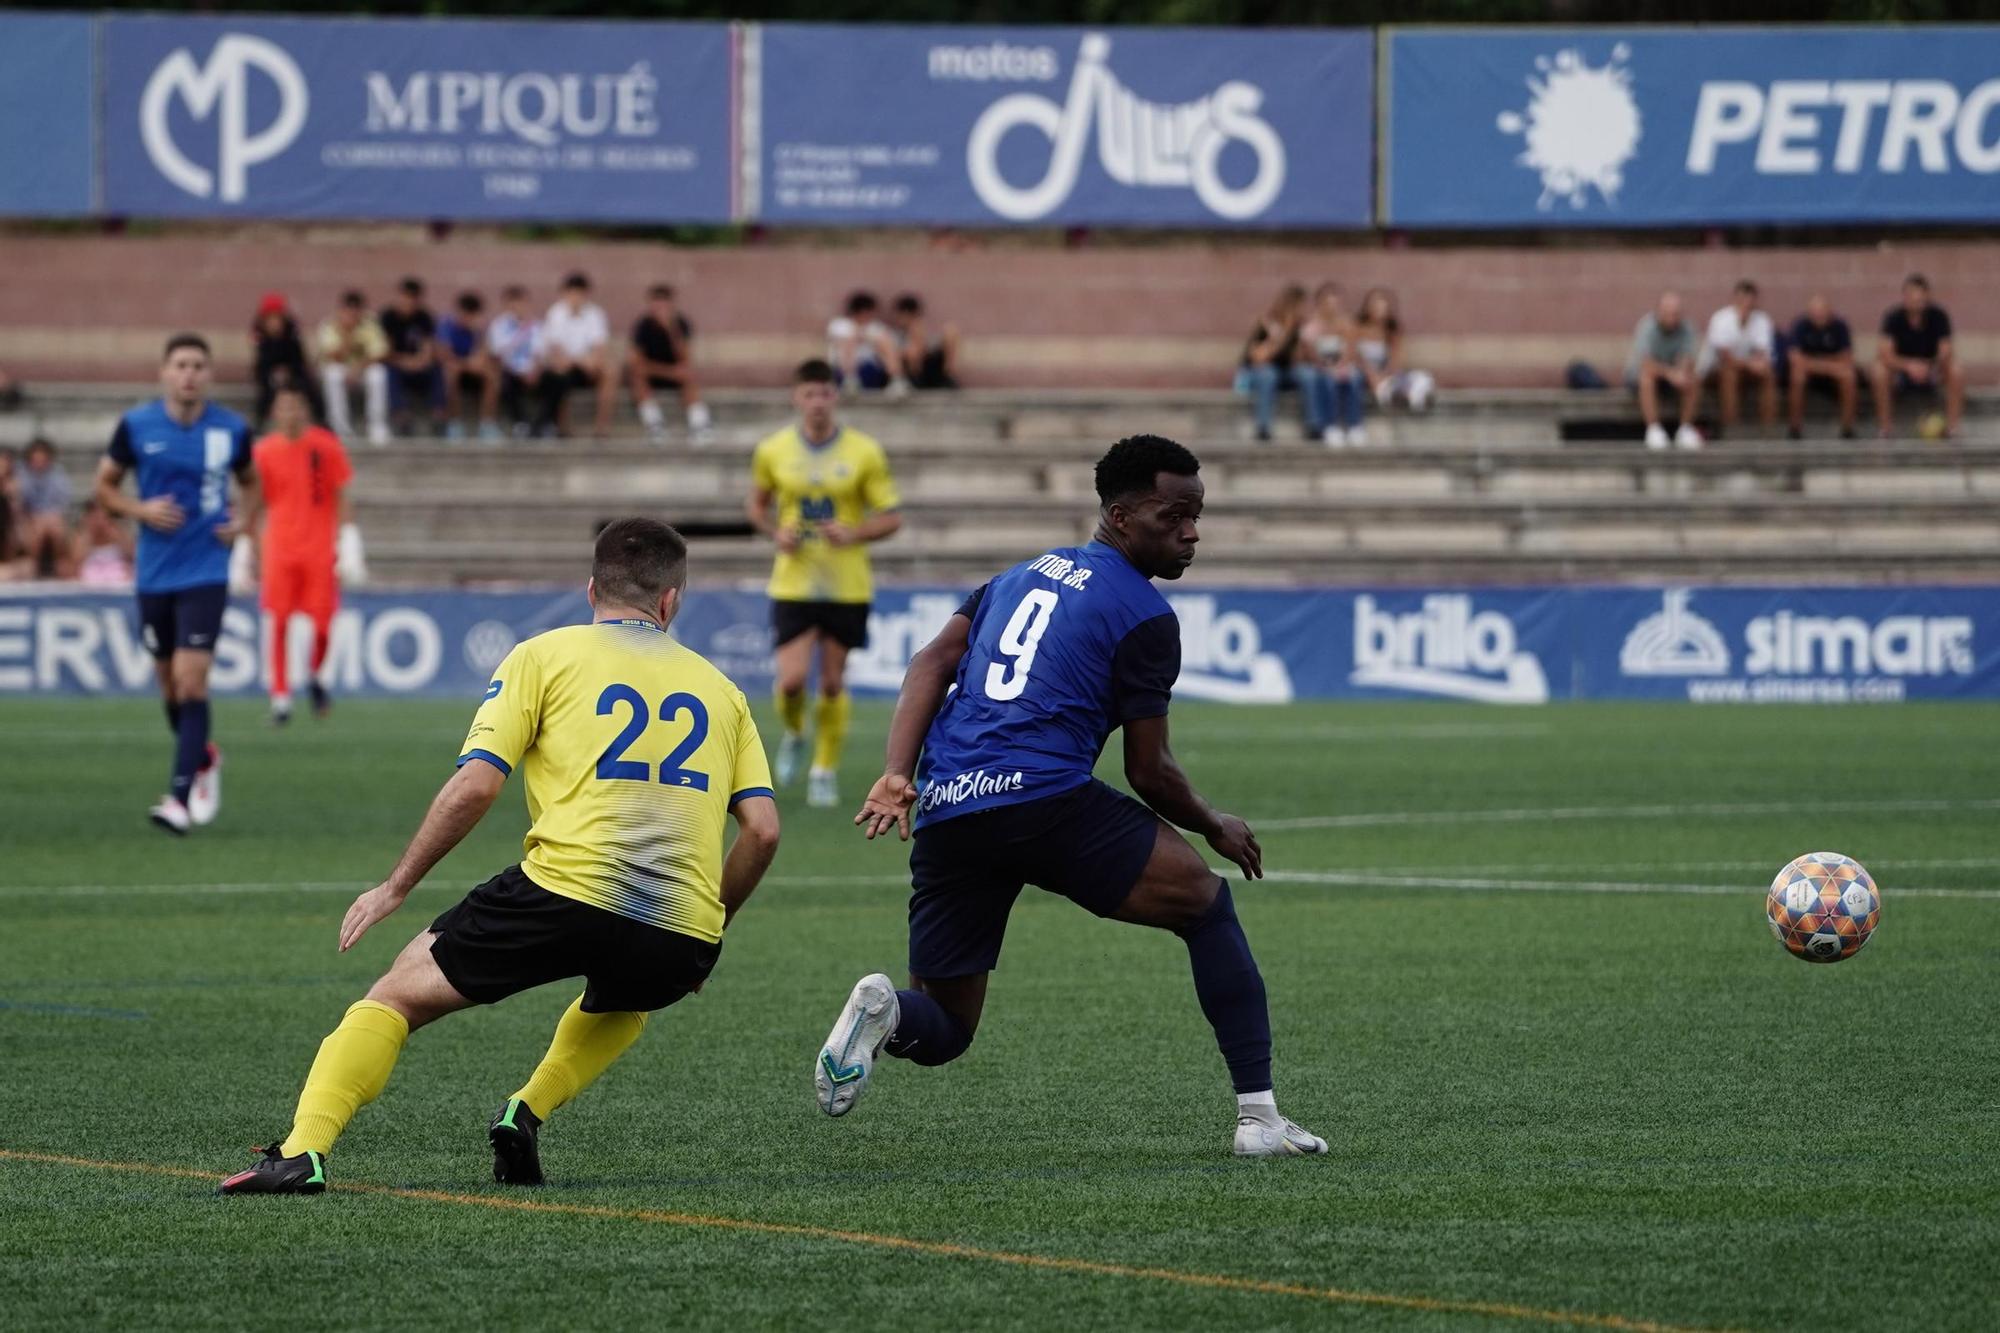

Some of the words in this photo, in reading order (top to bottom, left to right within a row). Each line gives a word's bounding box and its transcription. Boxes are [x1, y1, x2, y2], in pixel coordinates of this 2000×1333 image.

[928, 43, 1057, 81] motos
[1685, 79, 2000, 174] PETRO
[984, 588, 1059, 701] 9
[1353, 594, 1516, 673] brillo
[595, 683, 709, 793] 22
